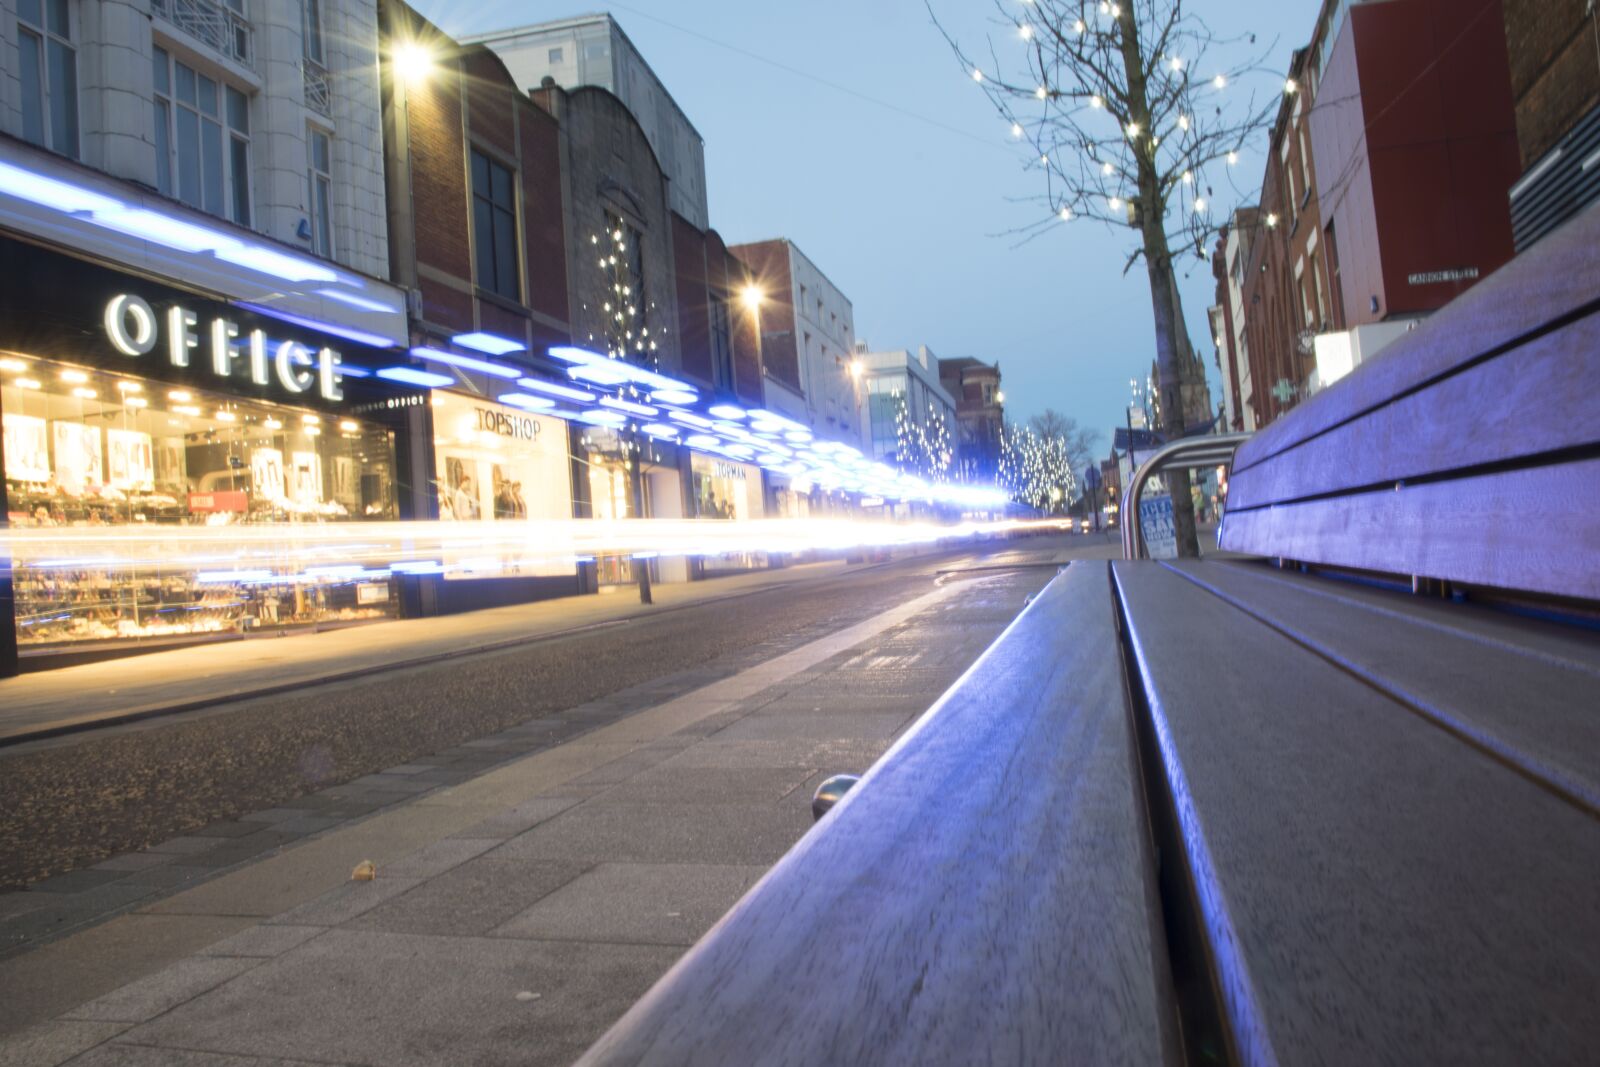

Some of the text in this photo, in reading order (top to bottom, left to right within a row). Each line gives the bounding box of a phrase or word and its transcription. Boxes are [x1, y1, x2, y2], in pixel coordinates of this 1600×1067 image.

[104, 293, 344, 401] OFFICE
[475, 406, 541, 441] TOPSHOP
[717, 462, 747, 480] TOPMAN
